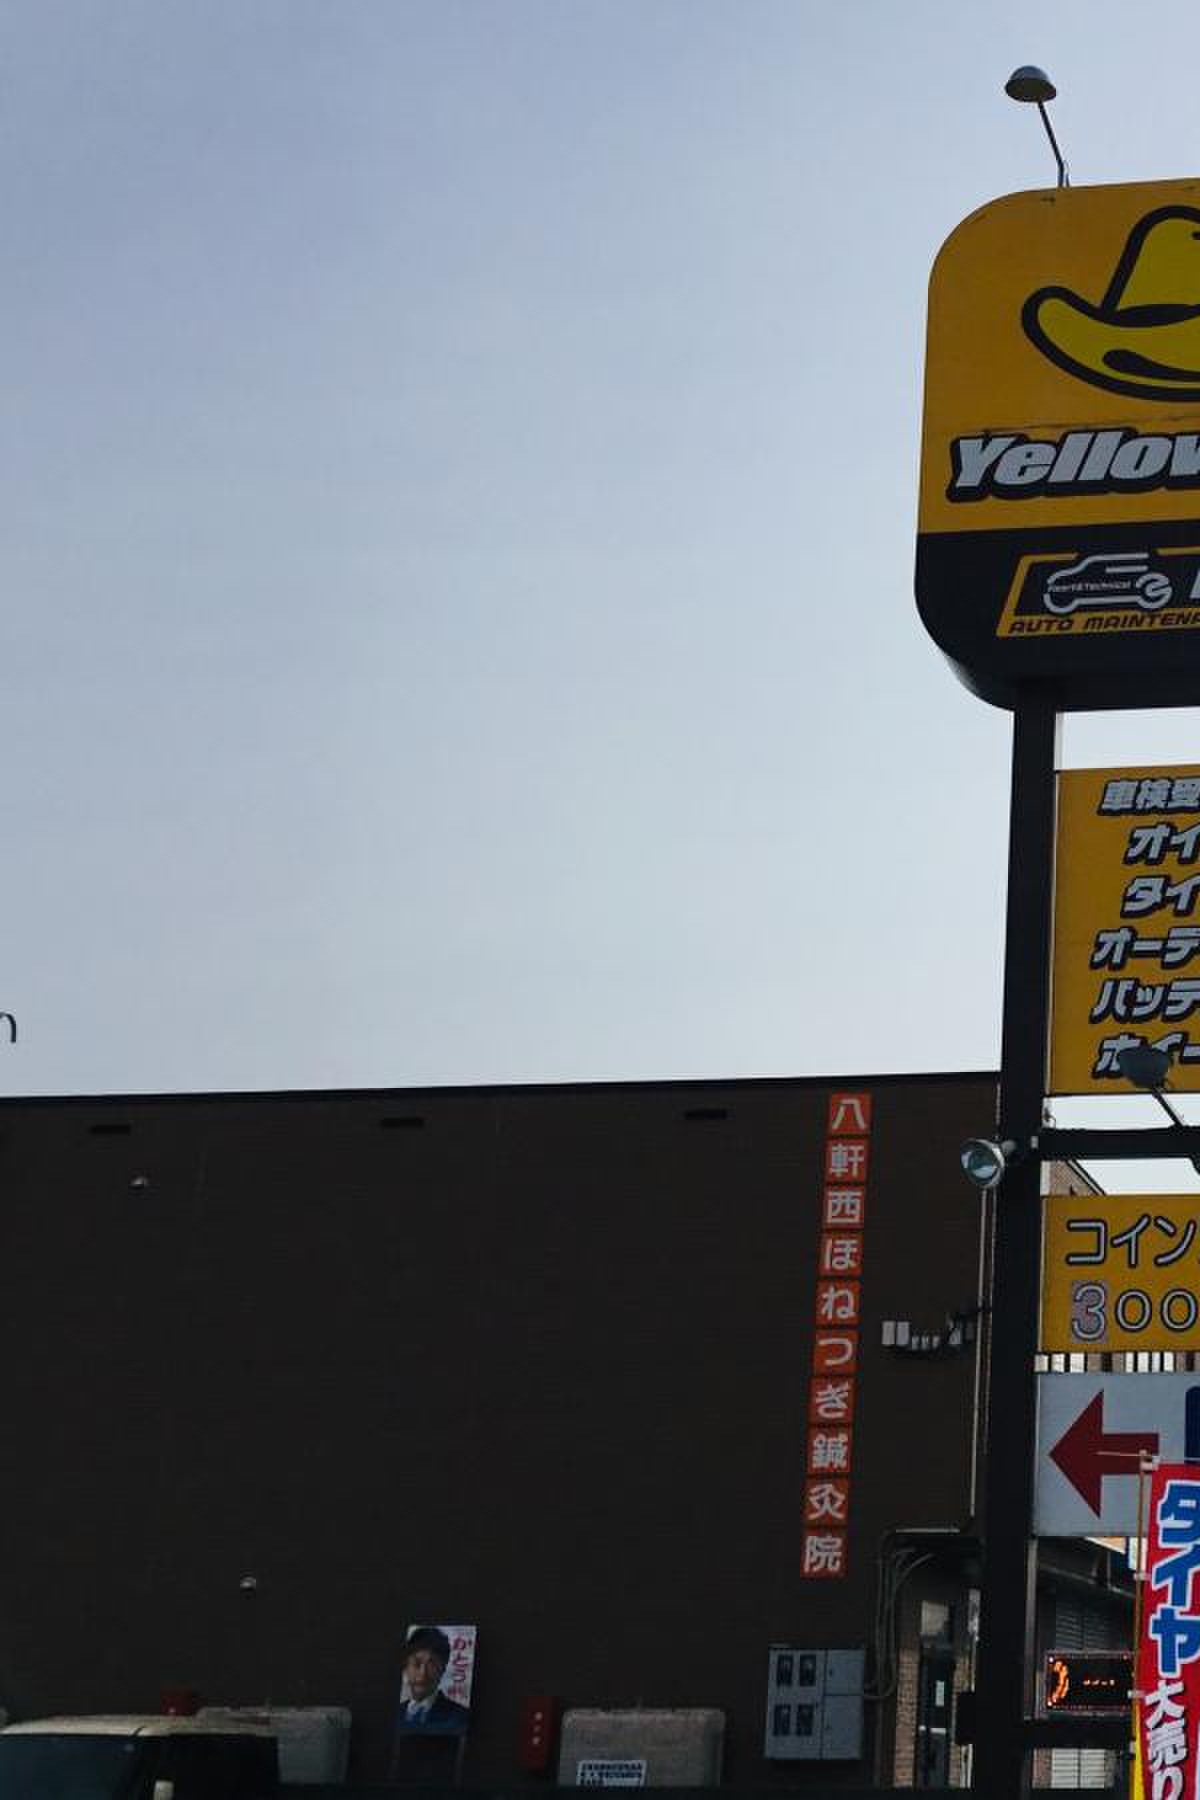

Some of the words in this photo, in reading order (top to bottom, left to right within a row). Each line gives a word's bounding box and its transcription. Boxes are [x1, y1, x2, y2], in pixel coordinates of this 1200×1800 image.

[1008, 619, 1075, 634] AUTO
[804, 1098, 869, 1573] 八軒西ほねつぎ鍼灸院
